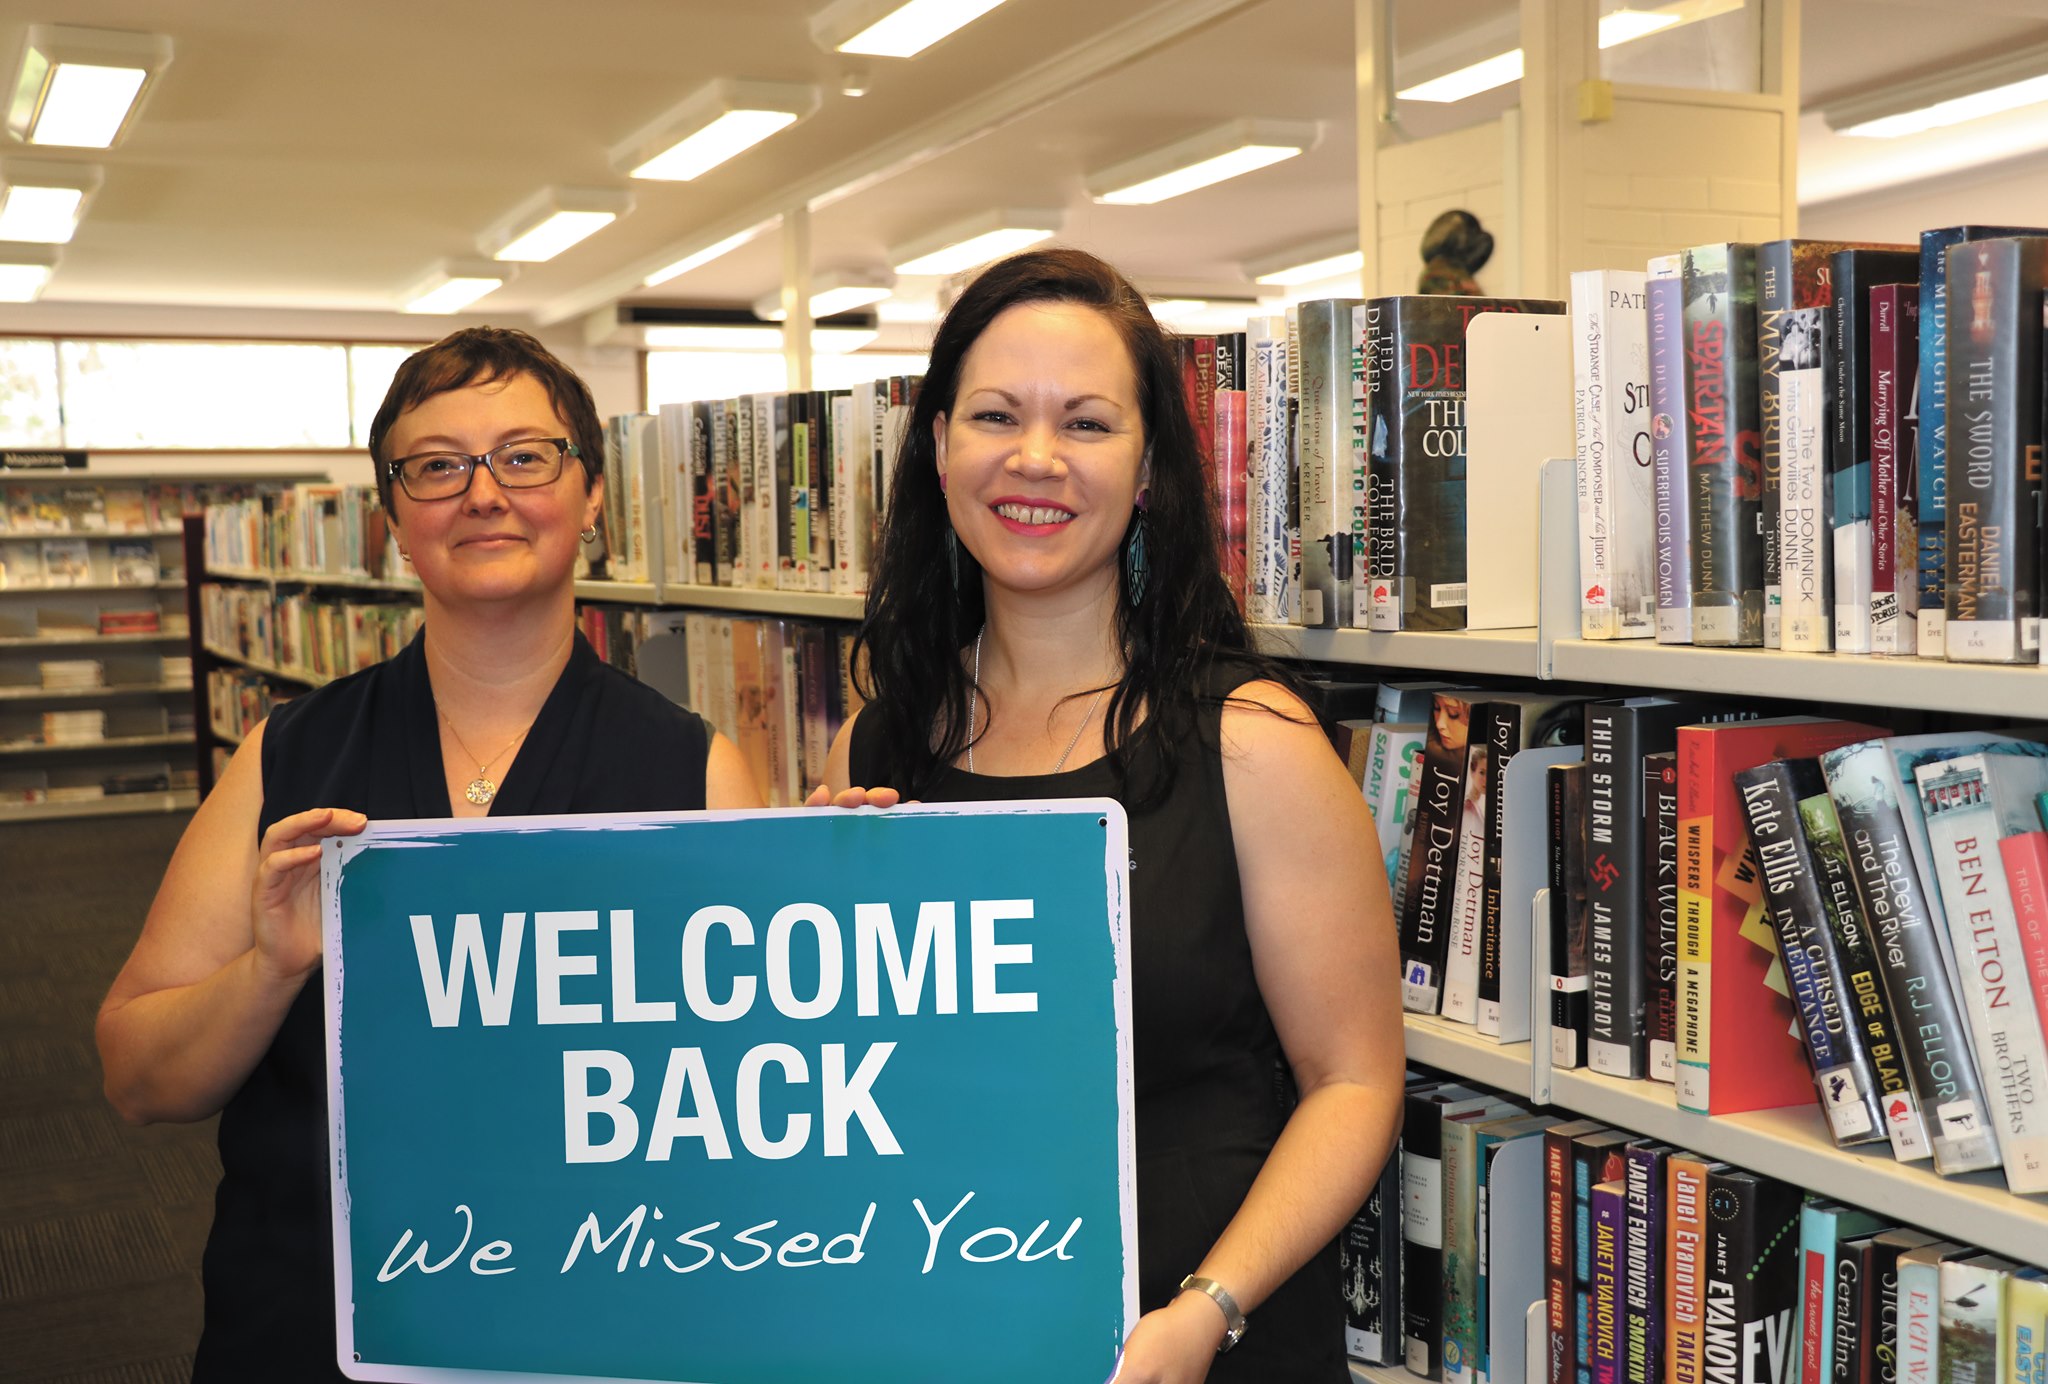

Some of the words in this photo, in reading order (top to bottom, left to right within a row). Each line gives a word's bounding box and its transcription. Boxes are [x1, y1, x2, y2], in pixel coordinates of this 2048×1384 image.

[1609, 290, 1646, 310] PAT
[1764, 267, 1776, 300] THE
[1837, 297, 1845, 319] Chris
[1653, 289, 1664, 356] CAROLA
[1761, 306, 1784, 379] MAY
[1933, 284, 1946, 412] MIDNIGHT
[1352, 344, 1363, 382] THE
[1367, 307, 1380, 393] DEKKER
[1380, 332, 1394, 372] TED
[1587, 333, 1602, 381] STRANGE
[1195, 352, 1213, 428] Deaver
[1588, 385, 1603, 412] CASE
[1655, 364, 1667, 405] DUNN
[1688, 319, 1725, 465] SPARTAN
[1874, 370, 1891, 425] Marrying
[1969, 357, 1993, 402] THE
[1312, 375, 1324, 444] Questions
[1352, 399, 1364, 448] LIFE
[1576, 389, 1586, 442] PATRICIA
[5, 453, 66, 467] Magazines
[1303, 438, 1310, 453] DE
[1313, 448, 1324, 461] of
[1762, 390, 1780, 492] BRIDE
[1786, 413, 1800, 501] Grenvilles
[1801, 427, 1815, 459] The
[1873, 428, 1892, 452] Off
[1933, 424, 1946, 509] WATCH
[1964, 411, 1993, 489] SWORD
[1303, 462, 1311, 521] KRETSER
[1314, 461, 1327, 504] Travel
[1353, 466, 1364, 491] TO
[1577, 445, 1587, 498] DUNCKER
[1589, 440, 1604, 505] COMPOSER
[1656, 449, 1671, 544] SUPERFLUOUS
[1801, 464, 1815, 500] Two
[1878, 453, 1891, 495] Mother
[1256, 491, 1264, 533] Course
[1380, 479, 1395, 521] THE
[1700, 473, 1712, 546] MATTHEW
[1878, 499, 1887, 515] and
[1353, 506, 1365, 556] COME
[1766, 530, 1775, 573] DUNN
[1784, 509, 1798, 571] DUNNE
[1800, 508, 1815, 602] DOMINICK
[1877, 516, 1888, 541] Other
[1659, 546, 1673, 607] WOMEN
[1701, 550, 1713, 593] DUNN
[1877, 543, 1887, 571] Stories
[1924, 537, 1938, 593] DYER
[1957, 503, 1979, 620] EASTERMAN
[1980, 526, 2001, 598] DANIEL
[1871, 593, 1897, 613] SHORT
[1494, 715, 1512, 750] Joy
[1592, 717, 1612, 764] THIS
[1369, 732, 1387, 798] SARAH
[1429, 766, 1460, 816] Joy
[1592, 775, 1612, 843] STORM
[1743, 777, 1782, 836] Kate
[1459, 833, 1470, 880] THORN
[1467, 830, 1484, 866] Joy
[1658, 791, 1677, 878] BLACK
[1687, 825, 1700, 889] WHISPERS
[1854, 829, 1882, 873] and
[1878, 834, 1901, 877] The
[1417, 822, 1454, 943] Dettman
[1759, 837, 1803, 895] Ellis
[1824, 858, 1842, 879] J.T.
[1954, 836, 1987, 896] BEN
[1462, 869, 1484, 956] Dettman
[1831, 880, 1860, 948] ELLISON
[1867, 872, 1890, 916] The
[1889, 876, 1921, 929] Devil
[2015, 867, 2035, 915] TRICK
[2027, 919, 2041, 941] OF
[1450, 916, 1462, 949] ROSE
[1485, 888, 1500, 979] Inheritance
[1594, 902, 1612, 963] JAMES
[1657, 883, 1676, 983] WOLVES
[1686, 901, 1700, 957] THROUGH
[1800, 925, 1817, 940] A
[1878, 917, 1907, 969] River
[409, 899, 1039, 1029] WELCOME
[1687, 968, 1698, 976] A
[1776, 907, 1830, 1060] INHERITANCE
[1969, 908, 2010, 1009] ELTON
[1594, 971, 1612, 1038] ELLROY
[1686, 979, 1698, 1054] MEGAPHONE
[1806, 945, 1843, 1035] CURSED
[1851, 970, 1884, 1017] EDGE
[1905, 976, 1932, 1018] R.J.
[1867, 1021, 1885, 1038] OF
[1661, 1060, 1673, 1068] ELL
[1991, 1031, 2026, 1134] BROTHERS
[2013, 1055, 2034, 1105] TWO
[562, 1041, 905, 1164] BACK
[1684, 1088, 1695, 1097] ELL
[1550, 1147, 1562, 1186] JANET
[1575, 1159, 1589, 1202] JANET
[1628, 1158, 1647, 1214] JANET
[1677, 1171, 1700, 1224] Janet
[376, 1203, 518, 1284] We
[560, 1201, 877, 1275] Missed
[912, 1190, 1083, 1274] You
[1550, 1191, 1562, 1266] EVANOVICH
[1576, 1203, 1590, 1282] EVANOVICH
[1598, 1221, 1615, 1272] JANET
[1717, 1233, 1727, 1275] JANET
[1627, 1216, 1647, 1309] EVANOVICH
[1676, 1229, 1699, 1324] Evanovich
[1811, 1279, 1822, 1299] the
[1551, 1278, 1563, 1329] FINGER
[1597, 1273, 1614, 1360] EVANOVICH
[1809, 1301, 1821, 1336] sweet
[1835, 1259, 1858, 1377] Geraldine
[1908, 1290, 1929, 1353] EACH
[1807, 1336, 1820, 1369] spot
